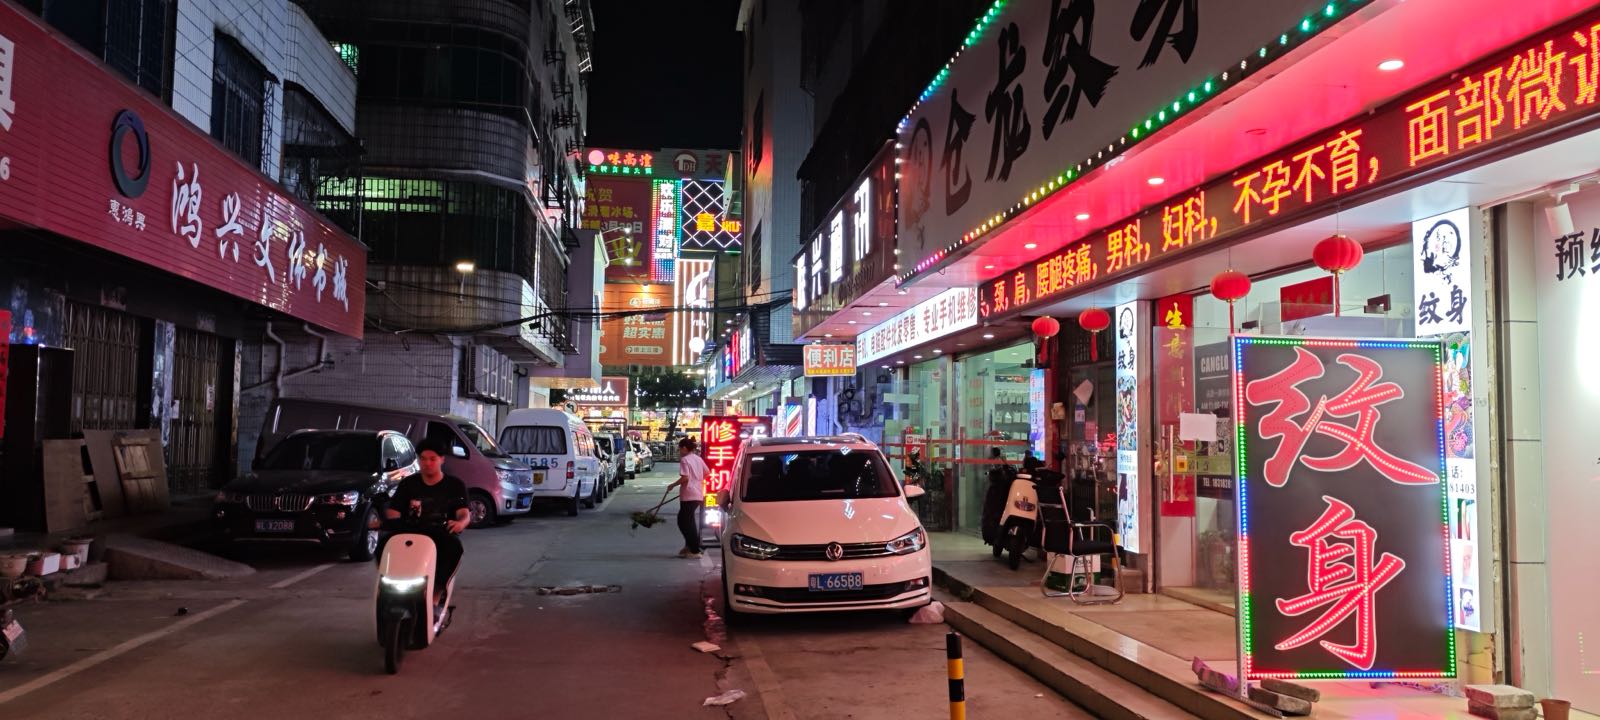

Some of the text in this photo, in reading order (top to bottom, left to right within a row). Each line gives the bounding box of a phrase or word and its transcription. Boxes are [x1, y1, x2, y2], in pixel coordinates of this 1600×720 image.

[1419, 284, 1467, 325] 纹身
[807, 347, 854, 368] 便利店
[1118, 347, 1136, 370] 纹身
[1246, 346, 1440, 671] 纹身
